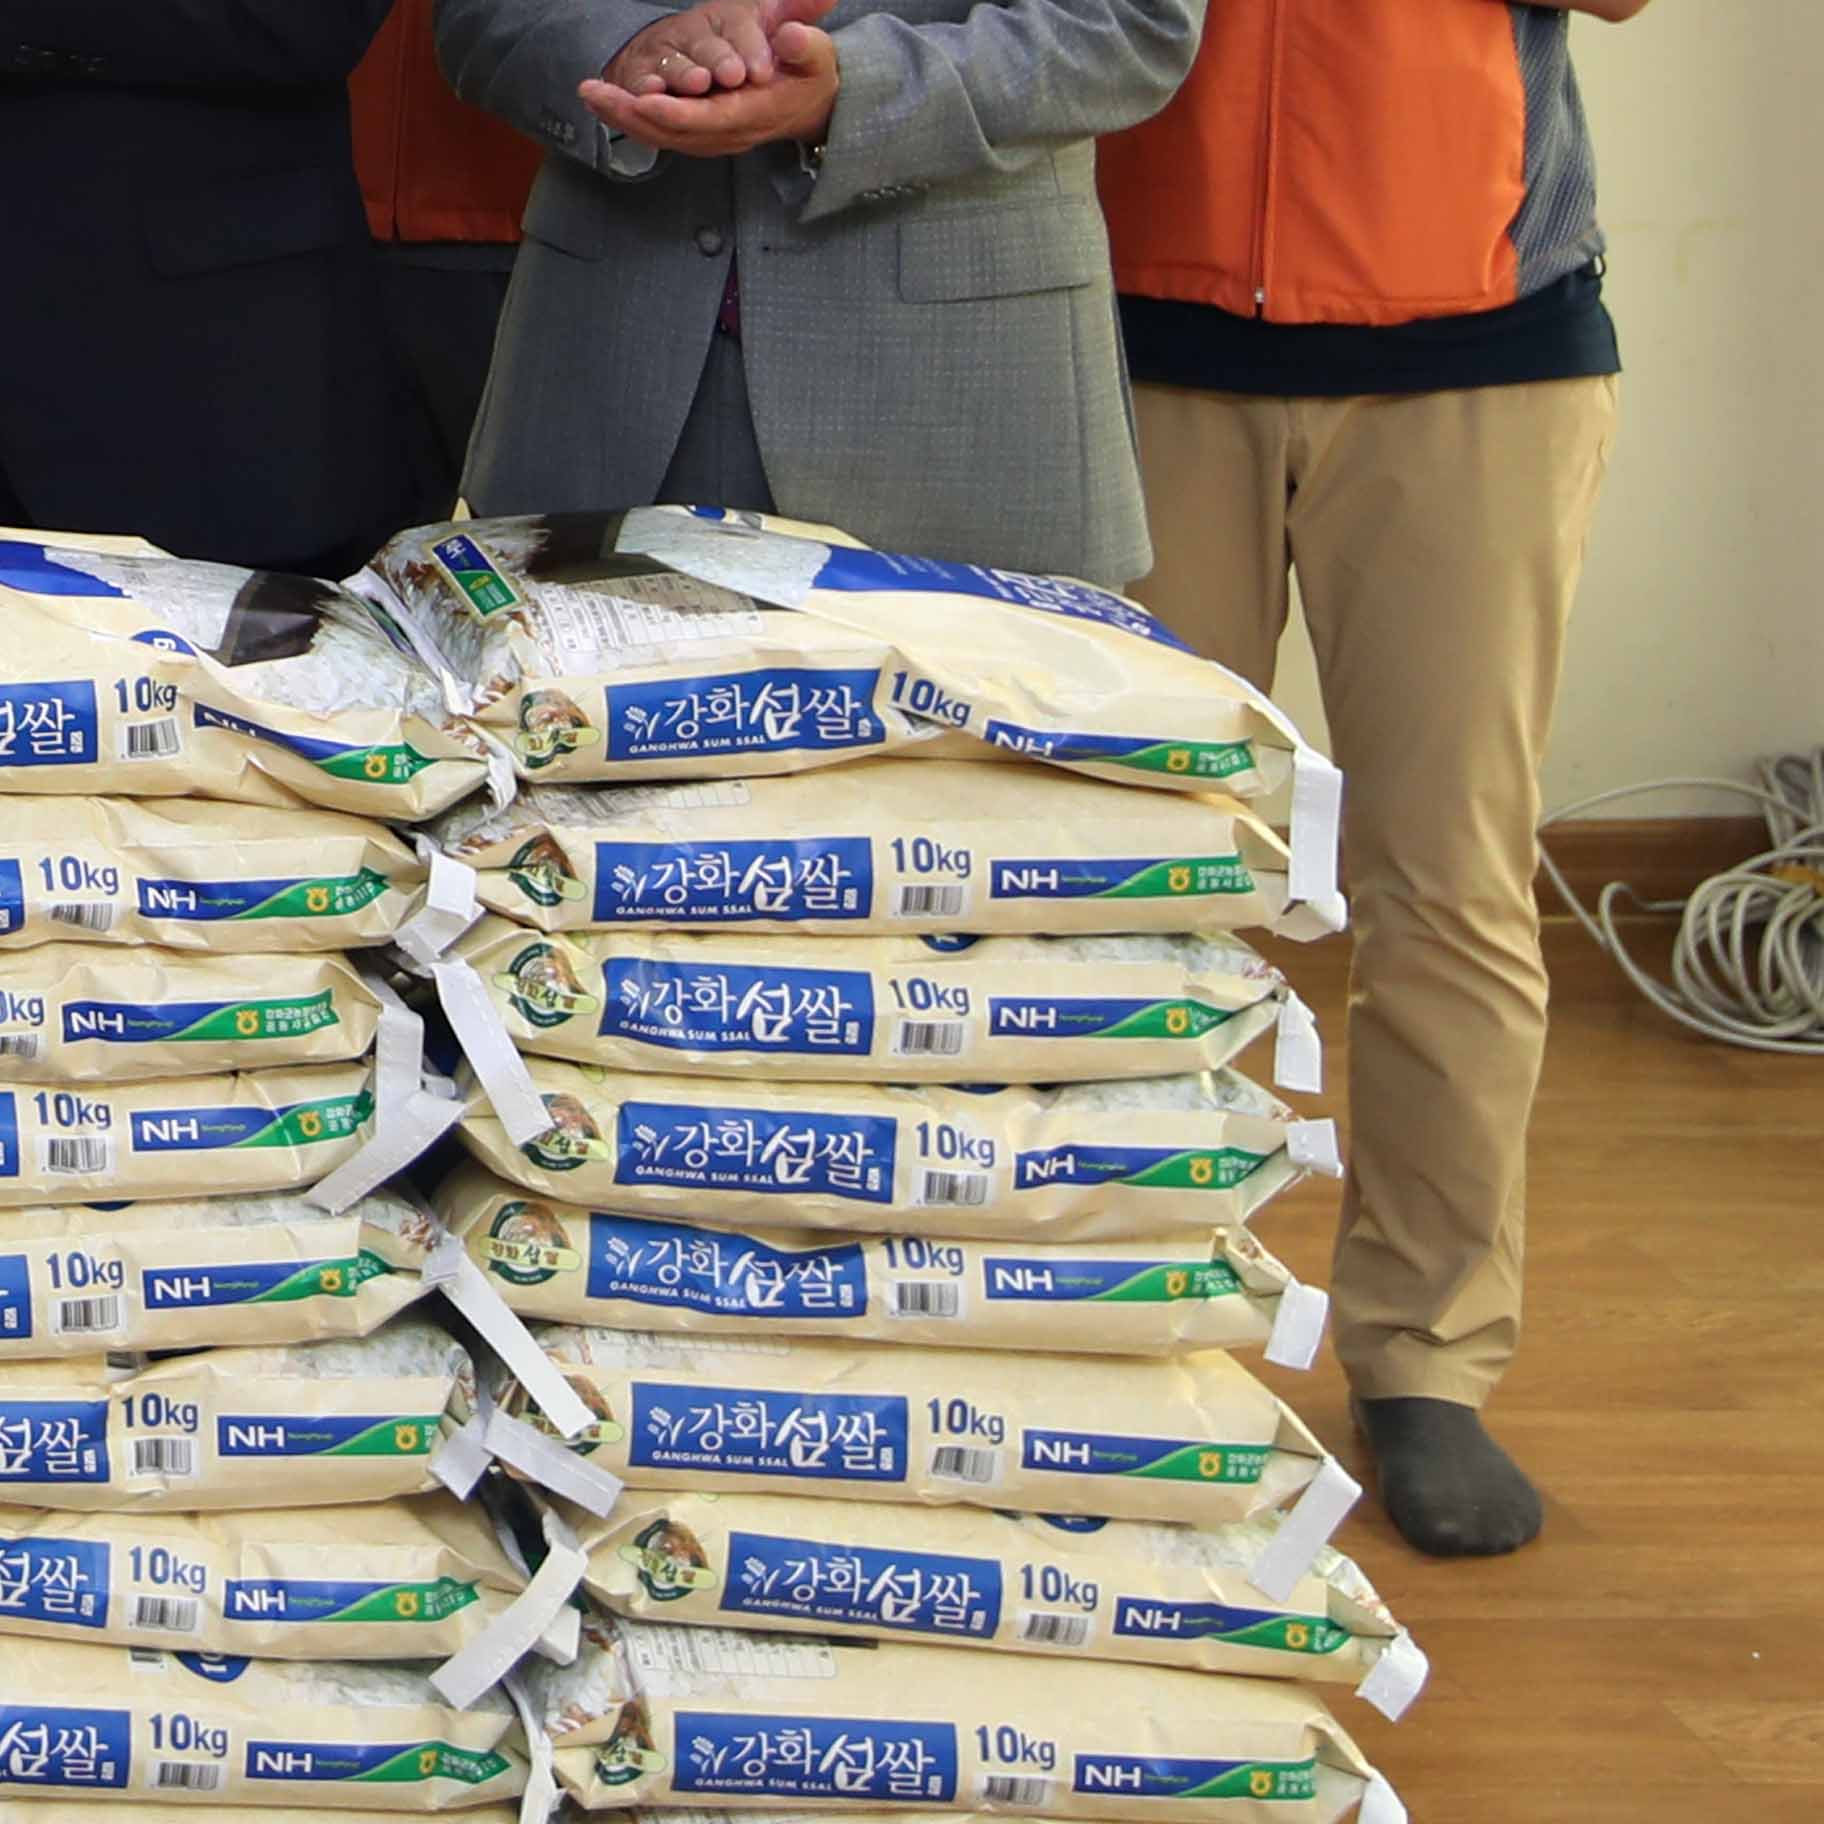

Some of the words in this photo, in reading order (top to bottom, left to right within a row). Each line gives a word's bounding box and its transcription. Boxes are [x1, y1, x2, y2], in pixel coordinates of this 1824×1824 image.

[115, 677, 178, 713] 10kg
[665, 683, 871, 740] 강화섬쌀
[892, 672, 972, 728] 10kg
[995, 732, 1053, 755] NH
[39, 856, 118, 895] 10kg
[891, 838, 971, 879] 10kg
[148, 887, 195, 910] NH
[652, 851, 857, 911] 강화섬쌀
[1002, 869, 1057, 890] NH
[649, 975, 859, 1044] 강화섬쌀
[890, 978, 969, 1016] 10kg
[71, 1011, 123, 1033] NH
[1000, 1007, 1056, 1028] NH
[34, 1092, 111, 1129] 10kg
[142, 1119, 198, 1141] NH
[917, 1122, 994, 1169] 10kg
[674, 1119, 880, 1181] 강화섬쌀
[1026, 1154, 1074, 1180] NH
[47, 1252, 123, 1289] 10kg
[880, 1237, 964, 1276] 10kg
[154, 1277, 210, 1299] NH
[996, 1268, 1052, 1290] NH
[122, 1393, 198, 1433] 10kg
[928, 1399, 1004, 1445] 10kg
[229, 1426, 284, 1447] NH
[689, 1402, 893, 1470] 강화섬쌀
[1034, 1440, 1089, 1464] NH
[130, 1547, 205, 1594] 10kg
[1021, 1565, 1098, 1612] 10kg
[236, 1589, 285, 1611] NH
[784, 1557, 985, 1630] 강화섬쌀
[1126, 1608, 1180, 1630] NH
[150, 1714, 227, 1758] 10kg
[976, 1726, 1055, 1771] 10kg
[257, 1752, 312, 1772] NH
[733, 1728, 932, 1795] 강화섬쌀
[1085, 1765, 1141, 1787] NH
